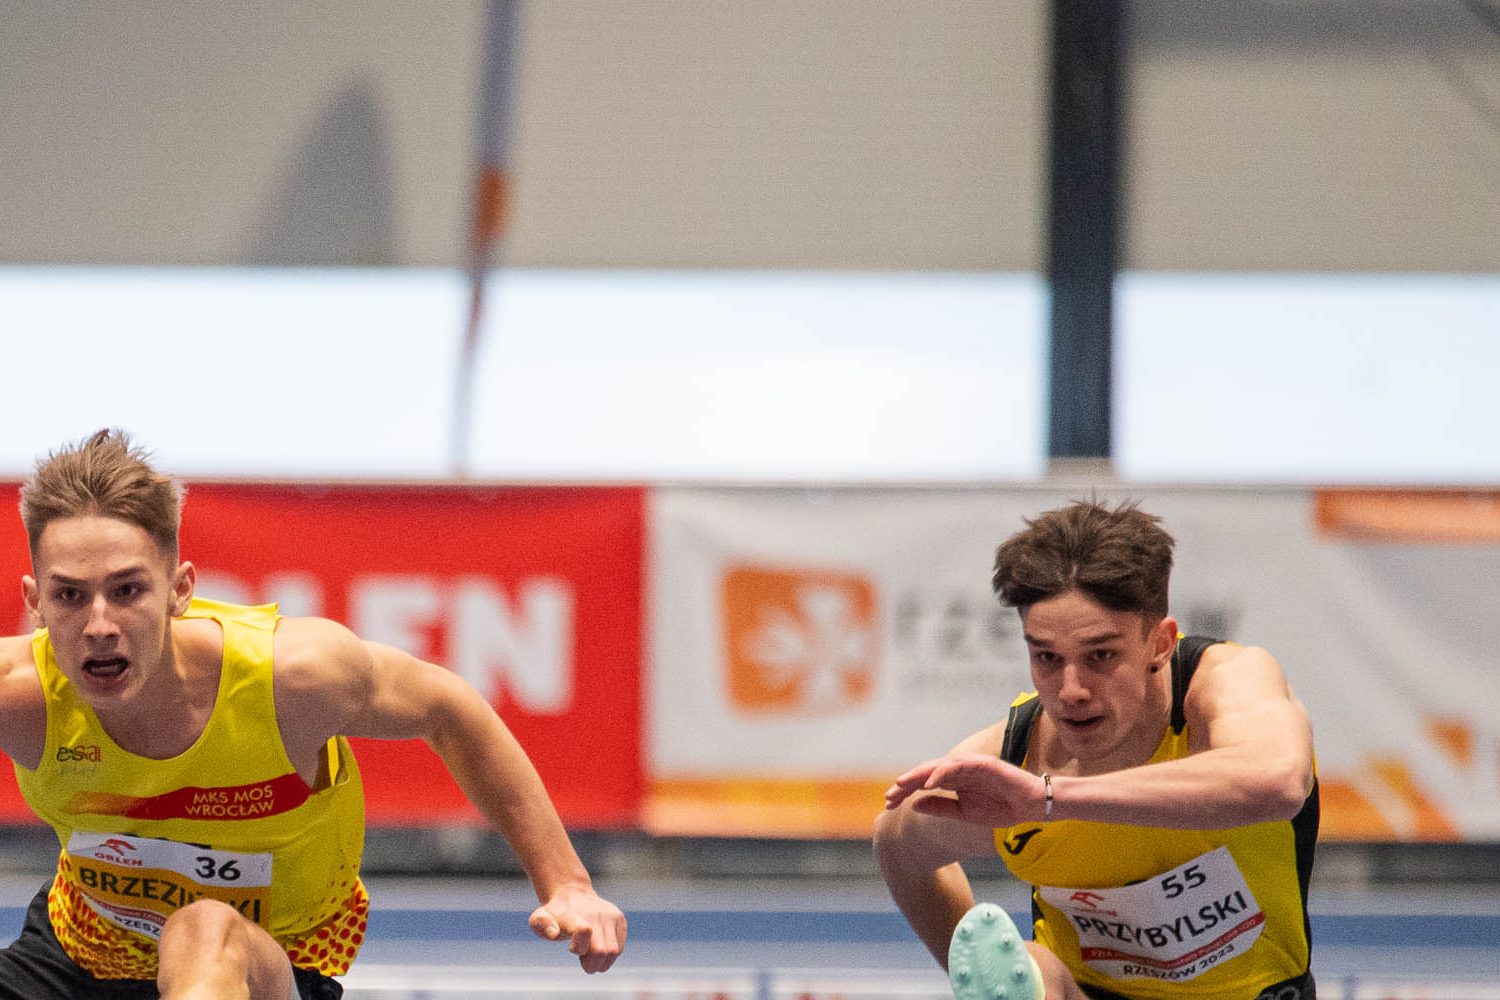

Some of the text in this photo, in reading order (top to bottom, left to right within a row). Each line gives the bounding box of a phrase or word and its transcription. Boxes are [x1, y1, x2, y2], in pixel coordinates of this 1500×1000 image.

[192, 784, 274, 805] MKS MOS
[94, 852, 143, 867] ORLEN
[195, 856, 241, 881] 36
[1160, 864, 1206, 899] 55
[1073, 890, 1249, 949] PRZYBYLSKI
[1199, 943, 1235, 969] 2023
